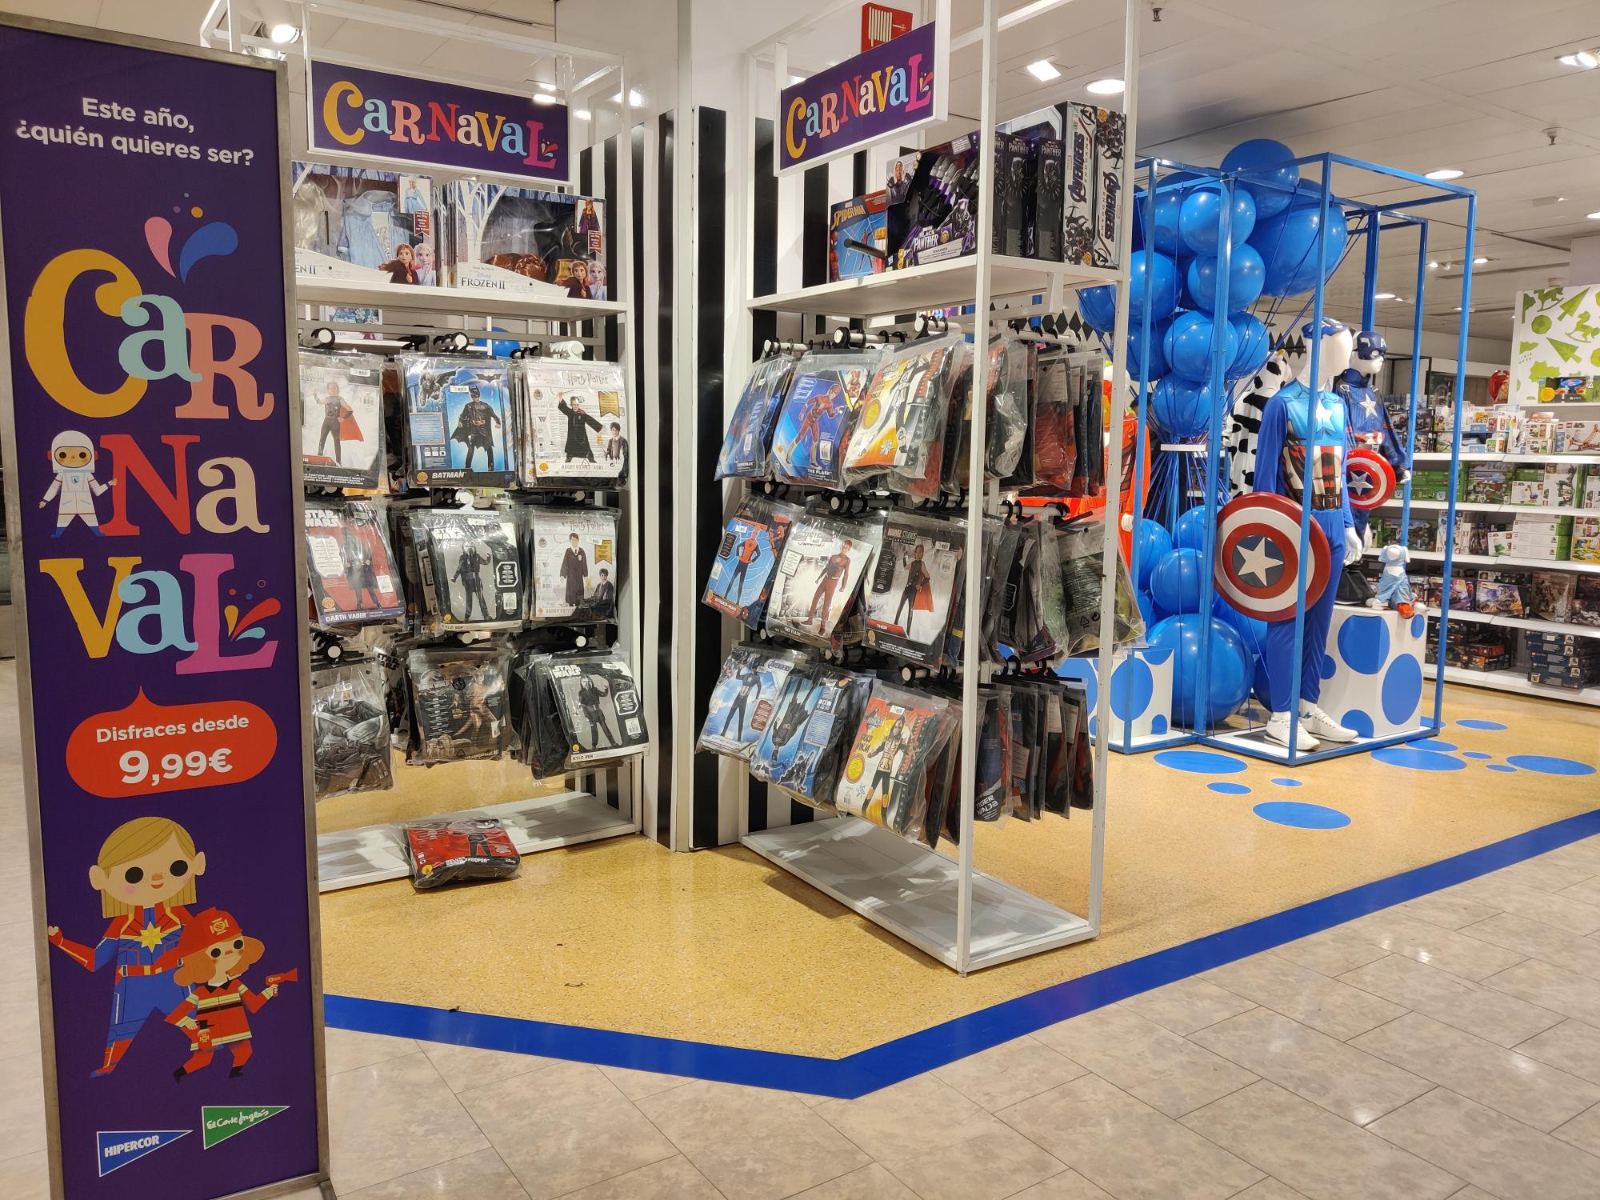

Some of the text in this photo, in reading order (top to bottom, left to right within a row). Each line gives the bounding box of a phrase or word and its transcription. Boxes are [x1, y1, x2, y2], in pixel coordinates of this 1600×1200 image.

[81, 97, 195, 133] Este año,
[16, 119, 255, 166] ¿quién quieres ser?
[461, 276, 498, 289] FROZEN
[432, 471, 465, 479] BATMAN
[96, 714, 250, 744] Disfraces desde
[119, 747, 233, 787] 9,99€
[104, 1135, 160, 1157] HIPERCOR
